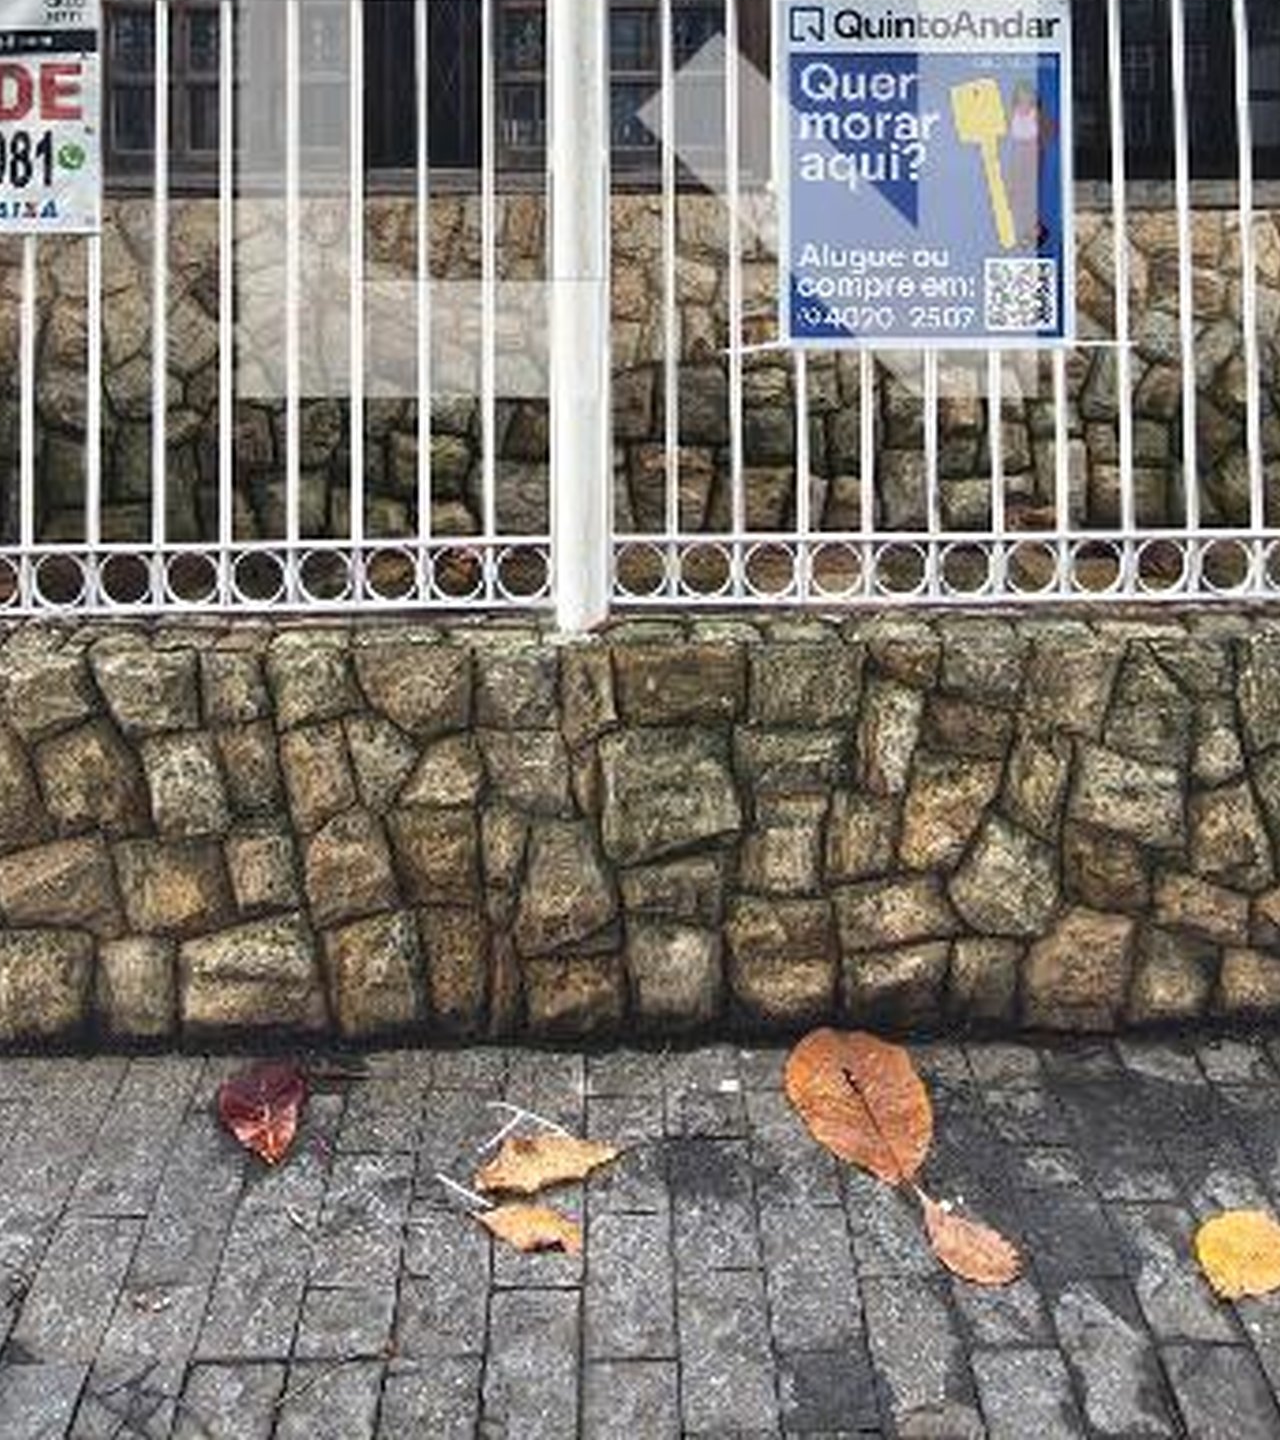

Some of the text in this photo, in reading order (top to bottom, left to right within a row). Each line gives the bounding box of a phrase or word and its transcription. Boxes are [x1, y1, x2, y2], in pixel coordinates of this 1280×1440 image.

[833, 10, 1061, 41] QuintoAndar
[800, 62, 918, 102] Quer
[799, 109, 941, 141] morar
[800, 142, 927, 192] aqui?
[798, 243, 949, 275] Alugue ou
[797, 276, 976, 303] compre em:
